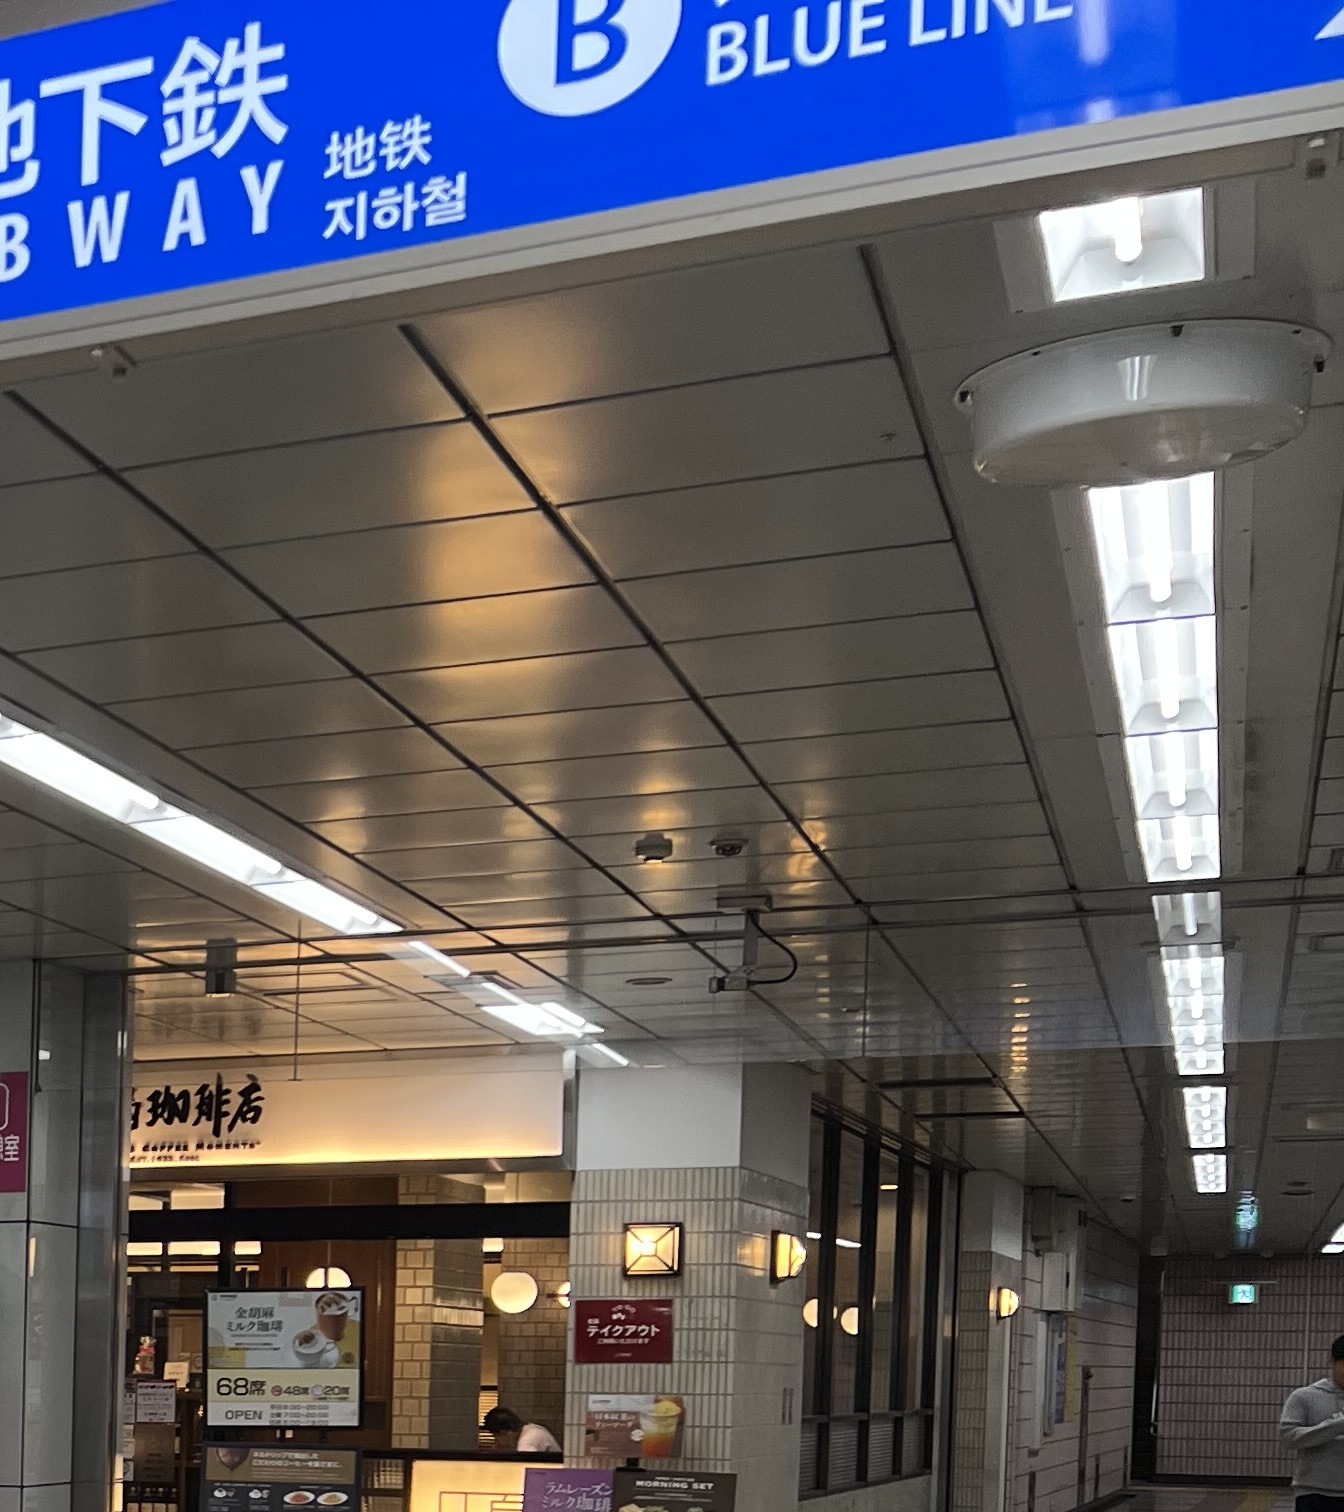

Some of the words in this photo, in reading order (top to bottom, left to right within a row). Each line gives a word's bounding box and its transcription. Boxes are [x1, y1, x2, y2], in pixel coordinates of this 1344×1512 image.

[553, 0, 629, 87] B
[706, 0, 887, 86] BLUE
[324, 115, 433, 181] 地铁
[323, 173, 469, 241] 지하철
[587, 1325, 660, 1337] テイクアウト
[216, 1377, 266, 1396] 68席
[224, 1410, 263, 1420] OPEN
[544, 1481, 612, 1496] ラムレーズン
[635, 1480, 688, 1489] MORNING
[692, 1482, 714, 1490] SET
